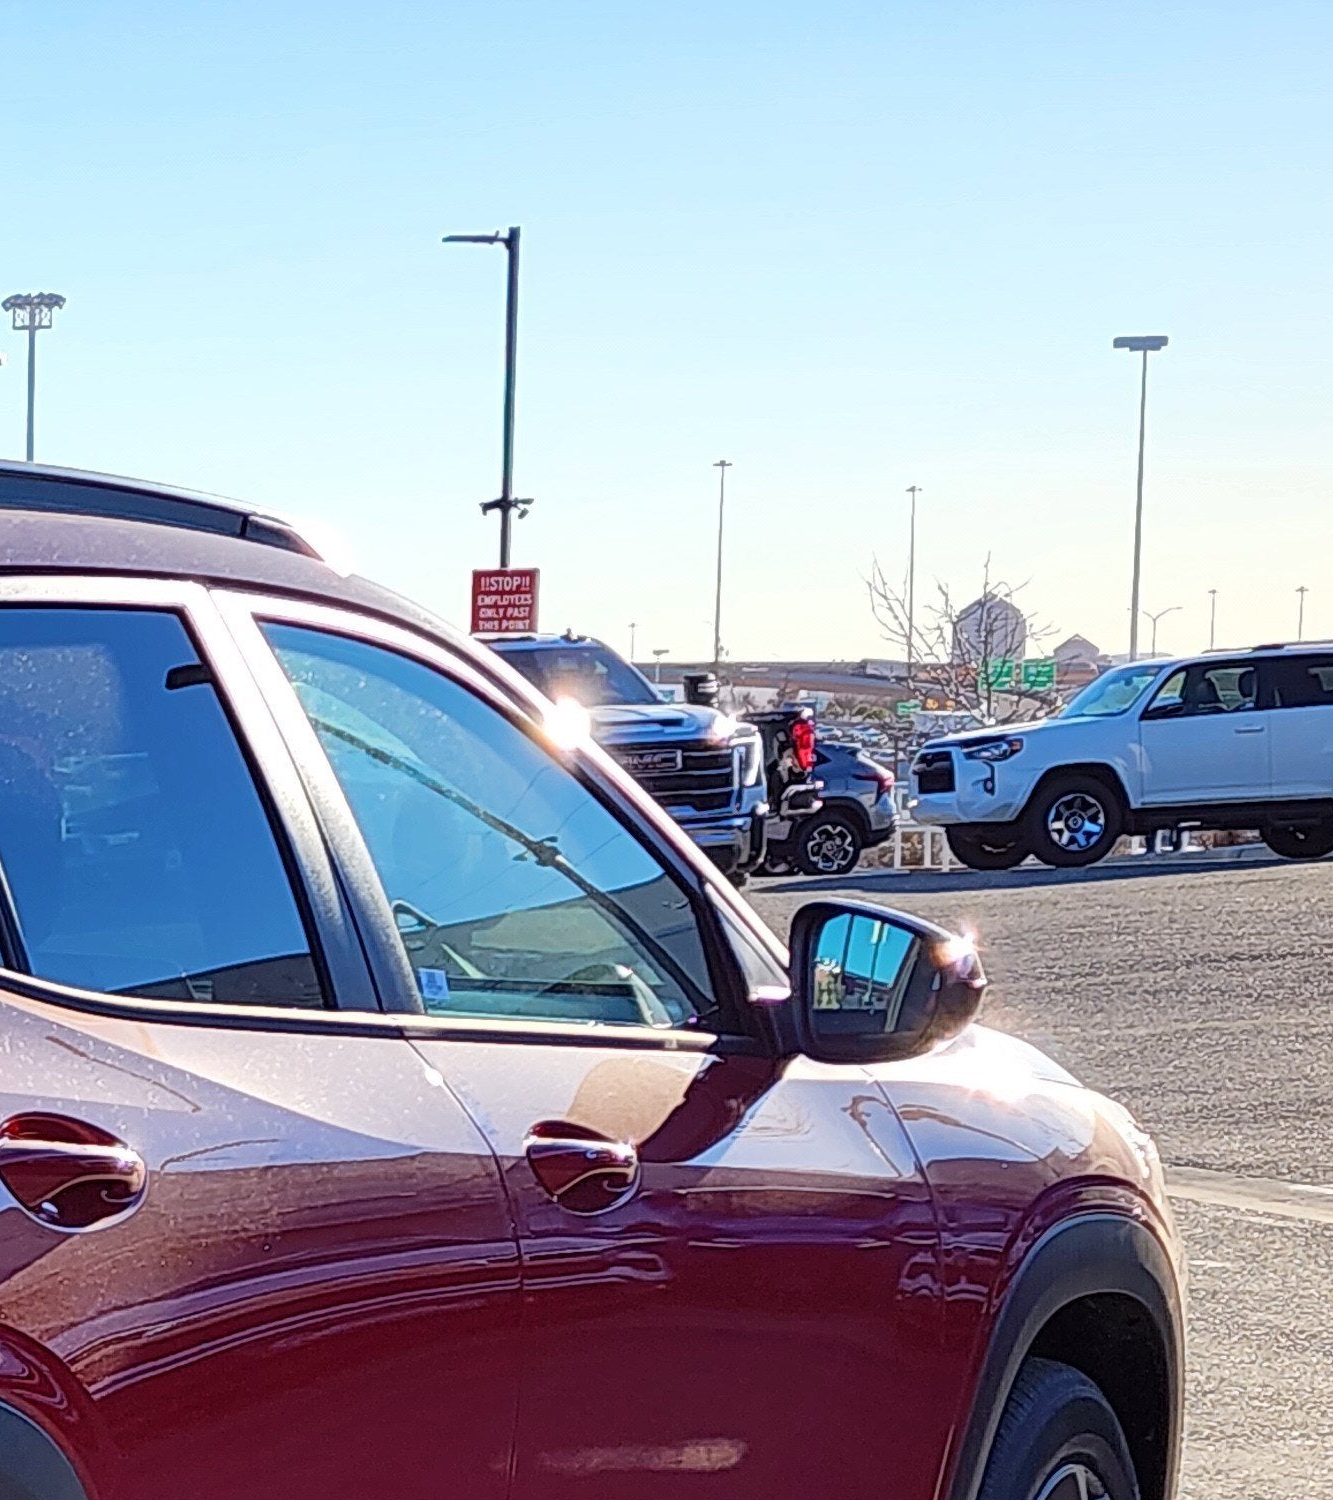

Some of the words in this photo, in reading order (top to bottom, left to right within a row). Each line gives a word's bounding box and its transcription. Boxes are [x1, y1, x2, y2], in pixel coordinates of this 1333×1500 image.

[477, 594, 532, 606] EMPLOYEES
[479, 607, 504, 618] ONLY
[506, 607, 530, 618] PAST
[478, 620, 499, 631] THIS
[501, 619, 530, 631] POINT
